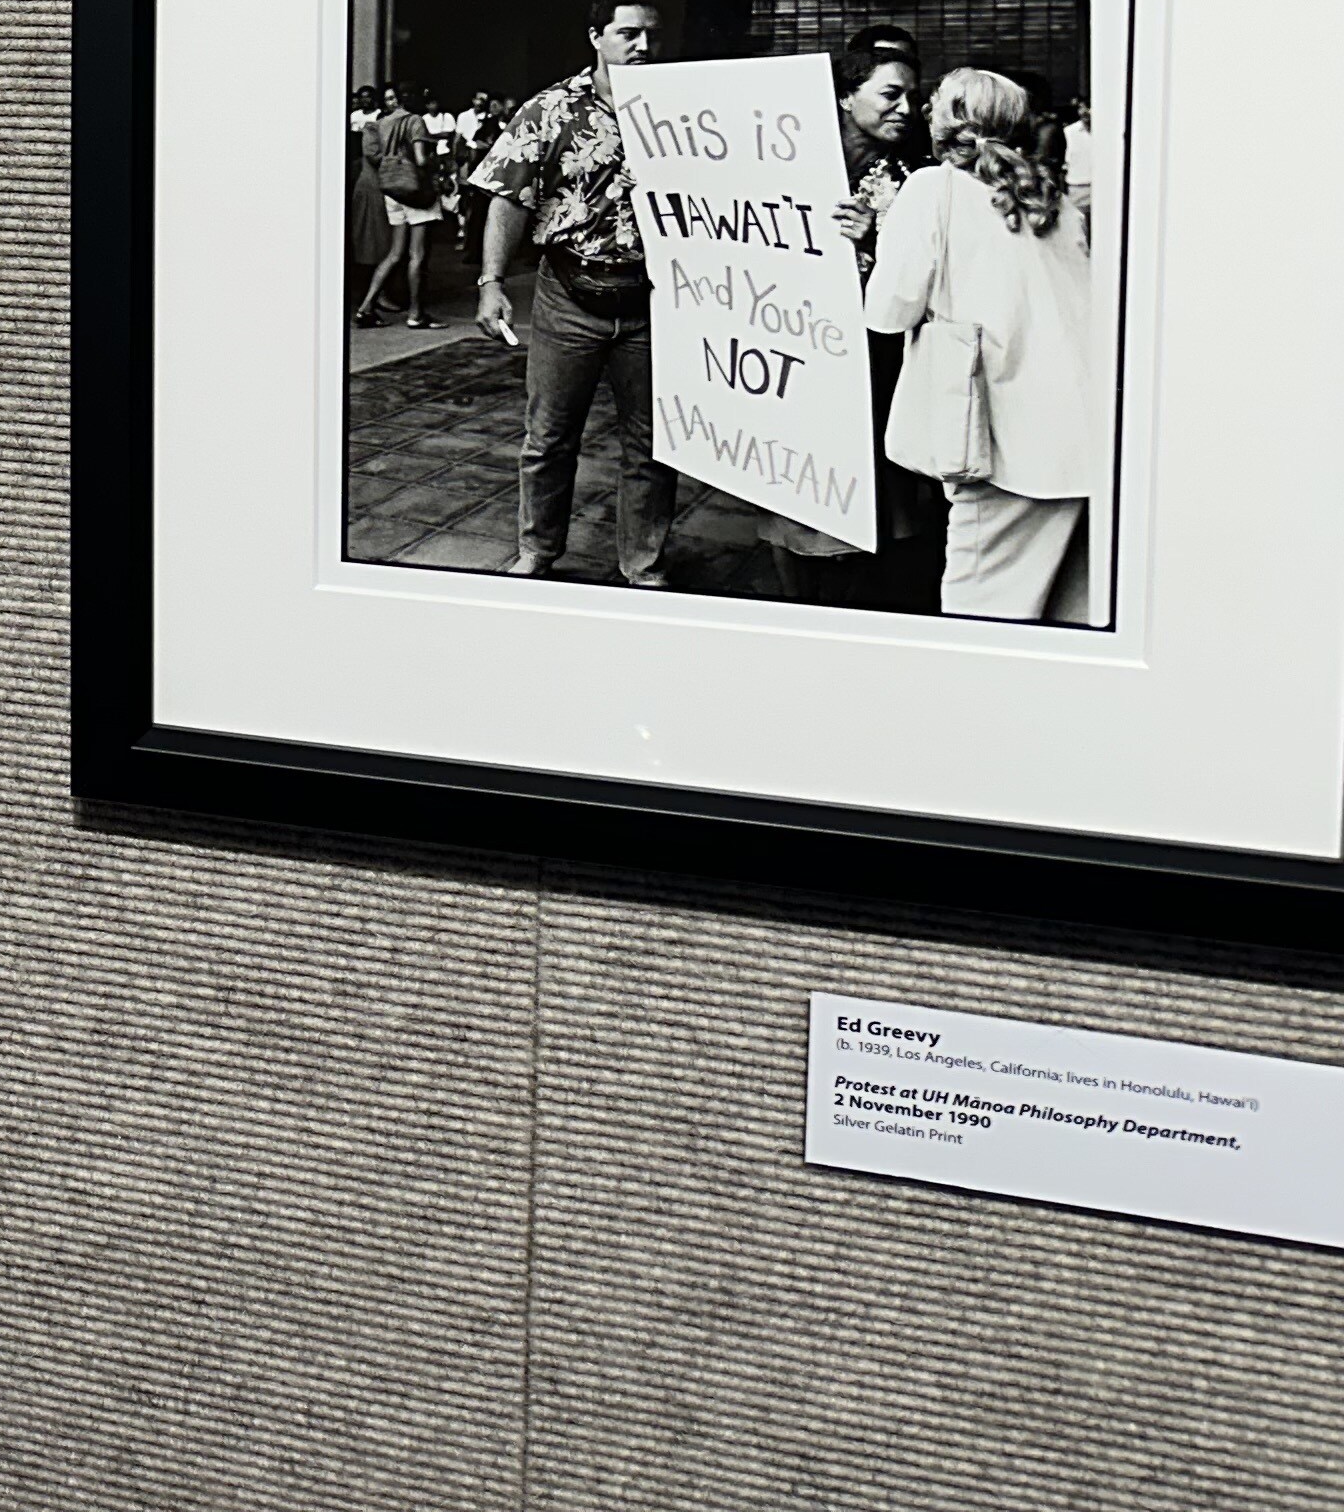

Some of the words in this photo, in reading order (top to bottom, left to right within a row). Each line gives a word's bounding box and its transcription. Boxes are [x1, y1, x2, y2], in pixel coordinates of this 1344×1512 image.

[618, 93, 728, 162] This
[756, 109, 801, 162] is
[646, 191, 823, 257] HAWAI'I
[670, 258, 734, 310] And
[743, 270, 848, 358] You're
[703, 337, 806, 399] NOT
[656, 394, 858, 516] HAWAIIAN
[837, 1016, 861, 1033] Ed
[867, 1021, 941, 1048] Greevy
[836, 1038, 853, 1050] (b.
[858, 1041, 892, 1058] 1939,
[896, 1047, 921, 1061] Los
[924, 1051, 986, 1072] Angeles,
[990, 1060, 1063, 1083] California;
[1066, 1071, 1099, 1087] lives
[1103, 1077, 1117, 1090] in
[1120, 1080, 1194, 1103] Honolulu,
[834, 1093, 844, 1106] 2
[849, 1095, 943, 1121] November
[949, 1111, 991, 1128] 1990
[834, 1075, 896, 1097] Protest
[899, 1088, 918, 1100] at
[922, 1089, 949, 1104] UH
[952, 1093, 1015, 1114] Mānoa
[1019, 1103, 1119, 1133] Philosophy
[1122, 1119, 1241, 1151] Department,
[834, 1114, 871, 1129] Silver
[874, 1120, 925, 1138] Gelatin
[929, 1128, 963, 1145] Print
